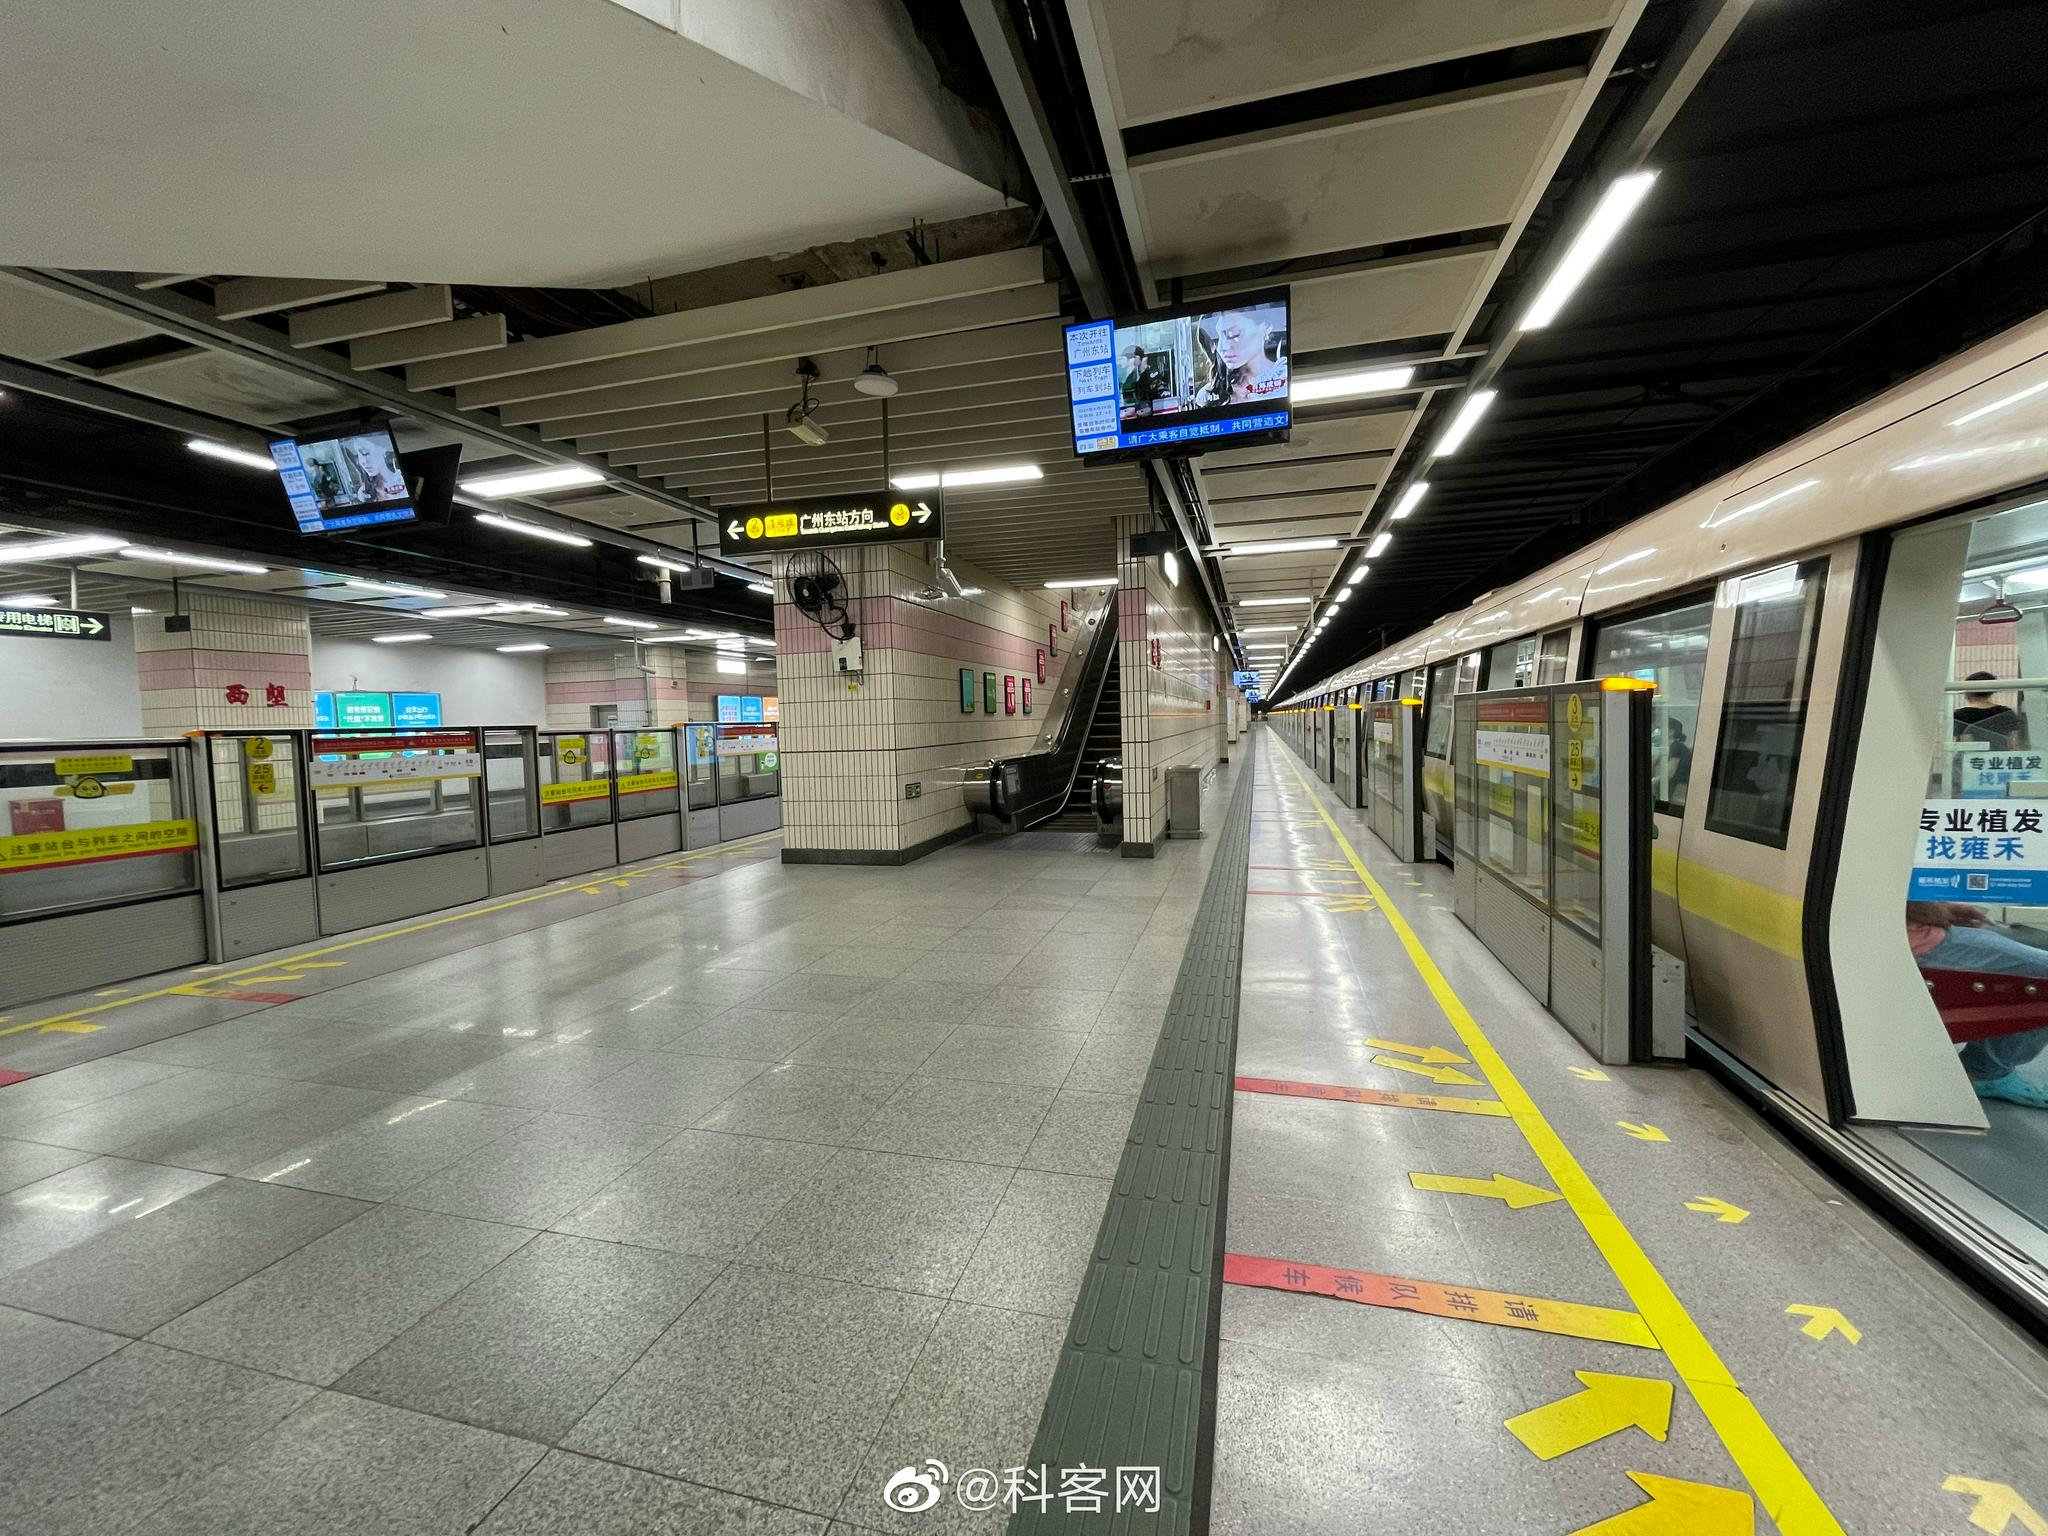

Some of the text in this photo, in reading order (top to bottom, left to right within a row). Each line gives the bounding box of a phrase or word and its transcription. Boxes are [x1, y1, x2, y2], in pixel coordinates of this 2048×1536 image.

[1069, 327, 1108, 341] 本次开往
[1074, 345, 1109, 359] 广州东站
[1074, 366, 1111, 379] 下趟列车
[1077, 384, 1112, 395] 列车到站
[800, 508, 874, 529] 广州东站方向
[226, 682, 289, 708] 西塱
[1572, 695, 1578, 714] 3
[256, 737, 264, 749] 2
[1570, 742, 1579, 757] 25
[254, 764, 270, 774] 25
[1970, 756, 2042, 770] 专业植发
[1920, 808, 2043, 833] 专业植发
[11, 826, 189, 856] 注意站台与列车之间的空隙
[1926, 835, 2024, 861] 找雍禾
[1282, 1267, 1539, 1323] 请排队候车
